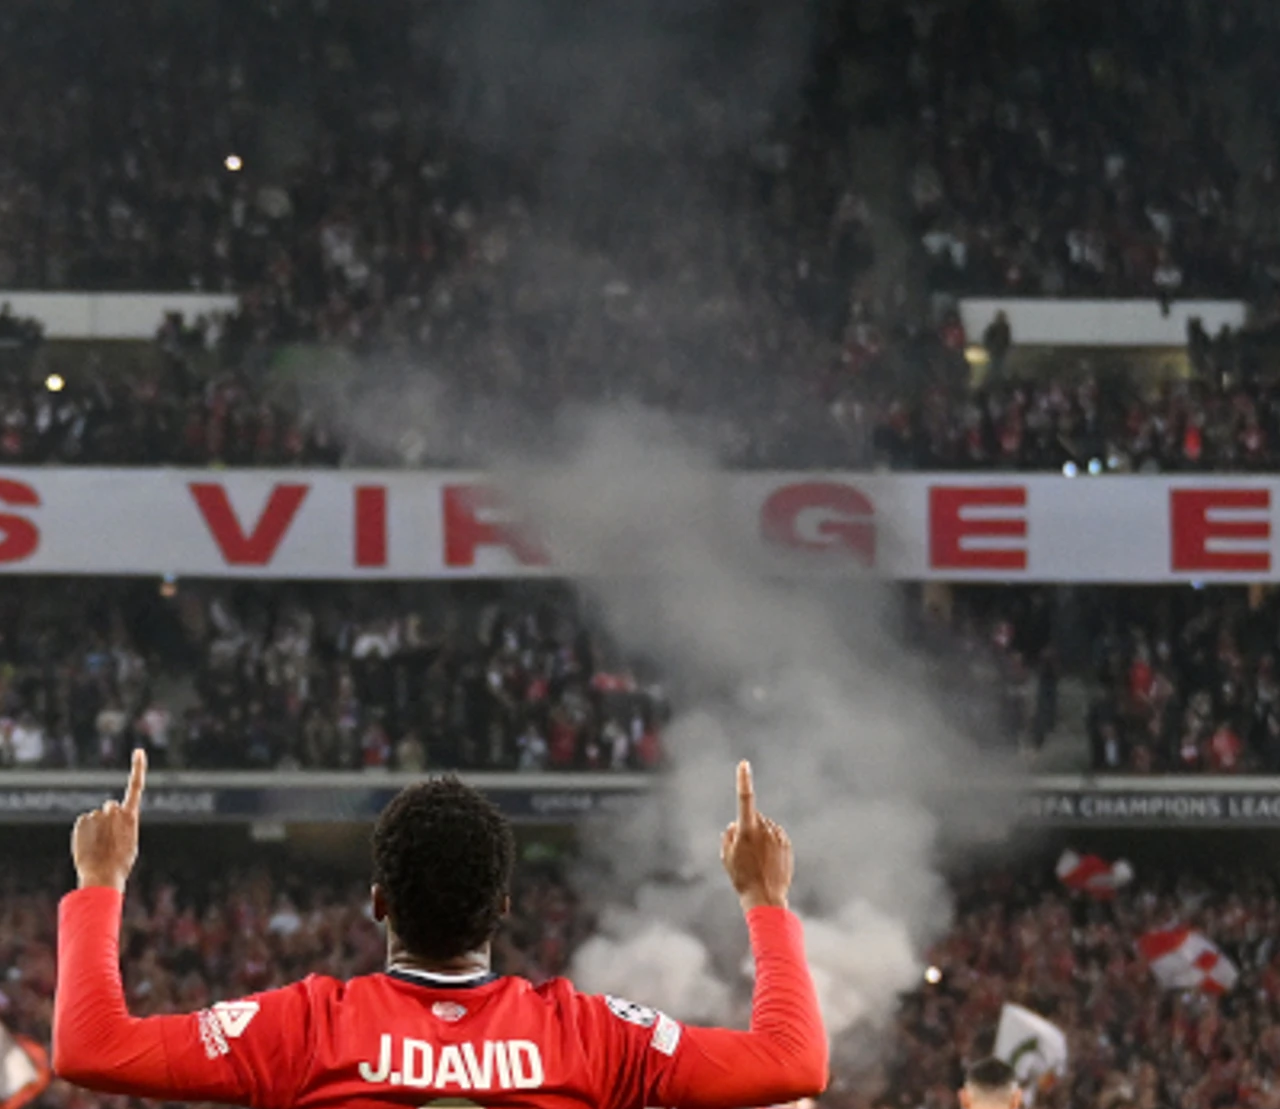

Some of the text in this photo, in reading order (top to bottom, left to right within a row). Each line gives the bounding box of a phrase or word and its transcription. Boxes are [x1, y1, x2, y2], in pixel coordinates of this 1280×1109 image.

[188, 481, 1028, 570] VIRGE
[1079, 795, 1221, 817] CHAMPIONS
[358, 1034, 544, 1089] J.DAVID
